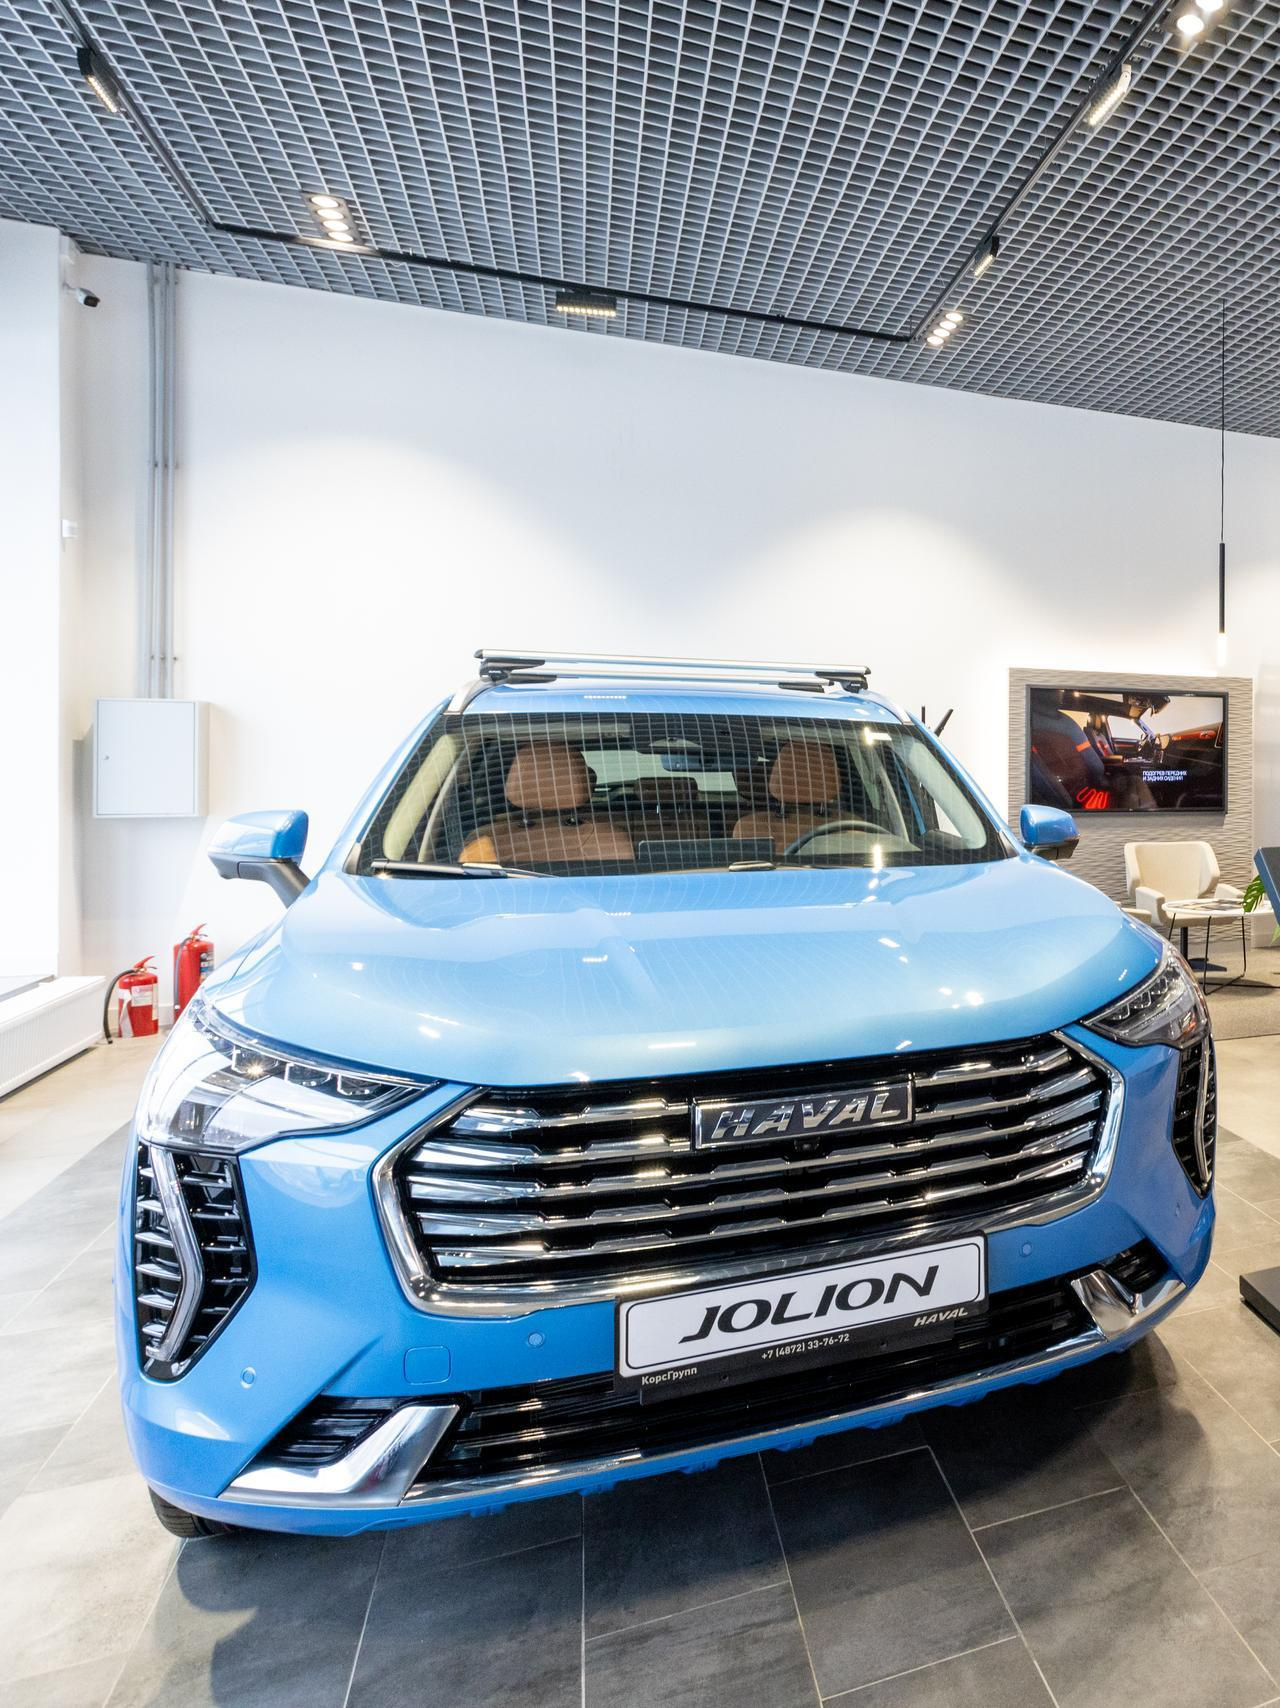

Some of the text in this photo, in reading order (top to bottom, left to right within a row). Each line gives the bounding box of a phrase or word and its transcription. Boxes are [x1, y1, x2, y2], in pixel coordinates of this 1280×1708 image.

[710, 1092, 901, 1140] HAVAL
[678, 1265, 940, 1345] JOLION
[913, 1307, 969, 1328] HAVAL
[761, 1333, 850, 1360] +7 (4872) 33-76-72
[641, 1367, 698, 1386] КорсГрупп
